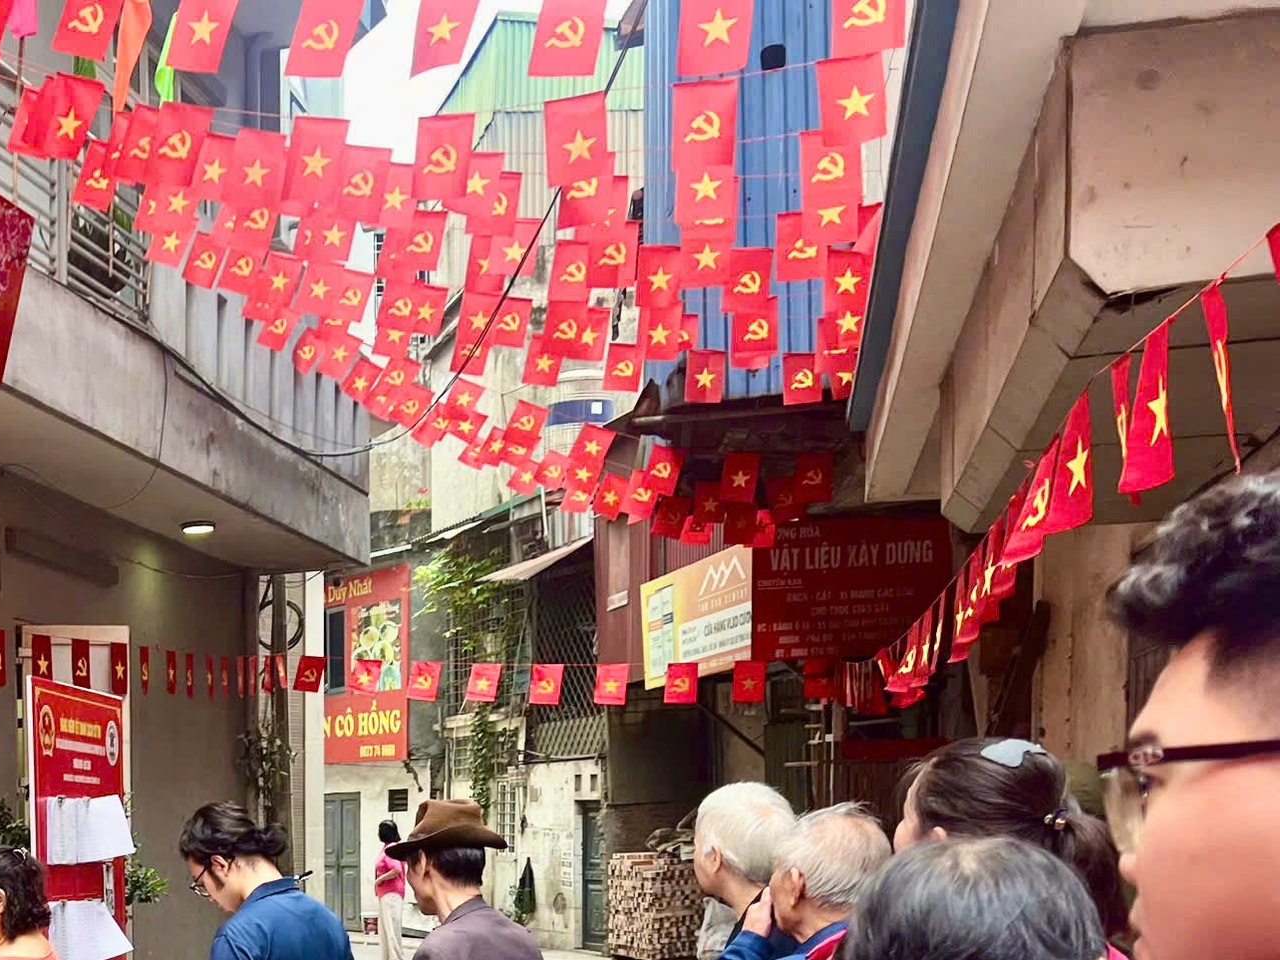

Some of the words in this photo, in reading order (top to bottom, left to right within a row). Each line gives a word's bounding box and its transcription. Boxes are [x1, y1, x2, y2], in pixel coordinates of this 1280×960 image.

[804, 541, 841, 574] LIỆU
[334, 706, 354, 738] CÔ
[357, 699, 401, 736] HỒNG
